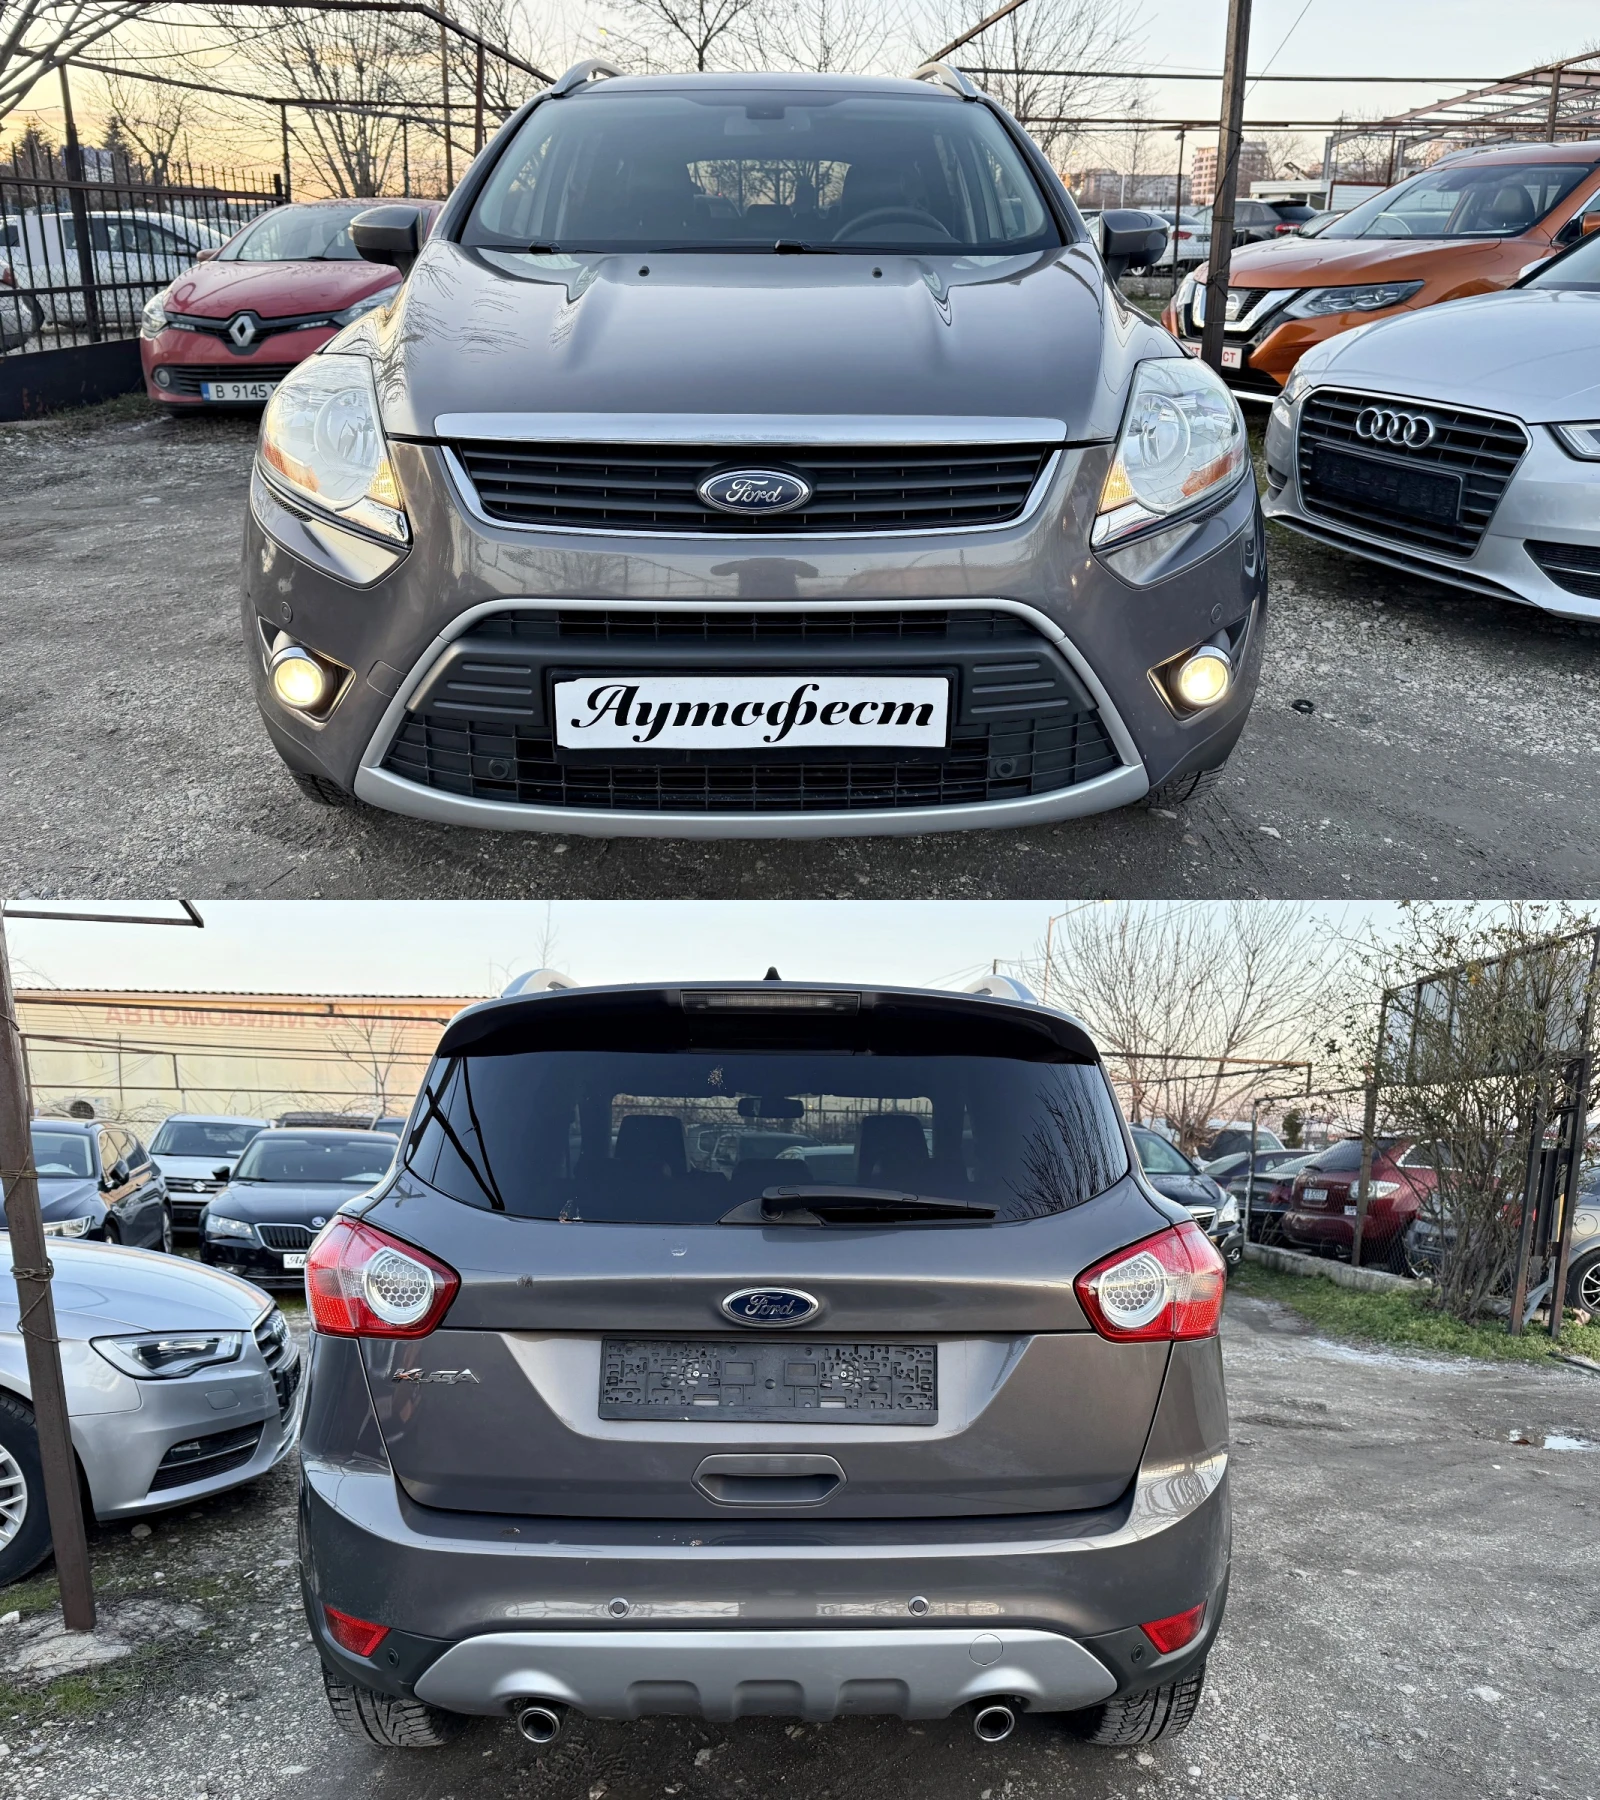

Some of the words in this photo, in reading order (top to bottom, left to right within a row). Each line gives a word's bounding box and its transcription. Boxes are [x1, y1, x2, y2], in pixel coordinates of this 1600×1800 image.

[232, 384, 268, 399] 9145
[725, 479, 784, 503] Ford
[570, 683, 934, 743] Аутофест
[744, 1294, 796, 1316] Ford
[392, 1368, 480, 1385] KUGA
